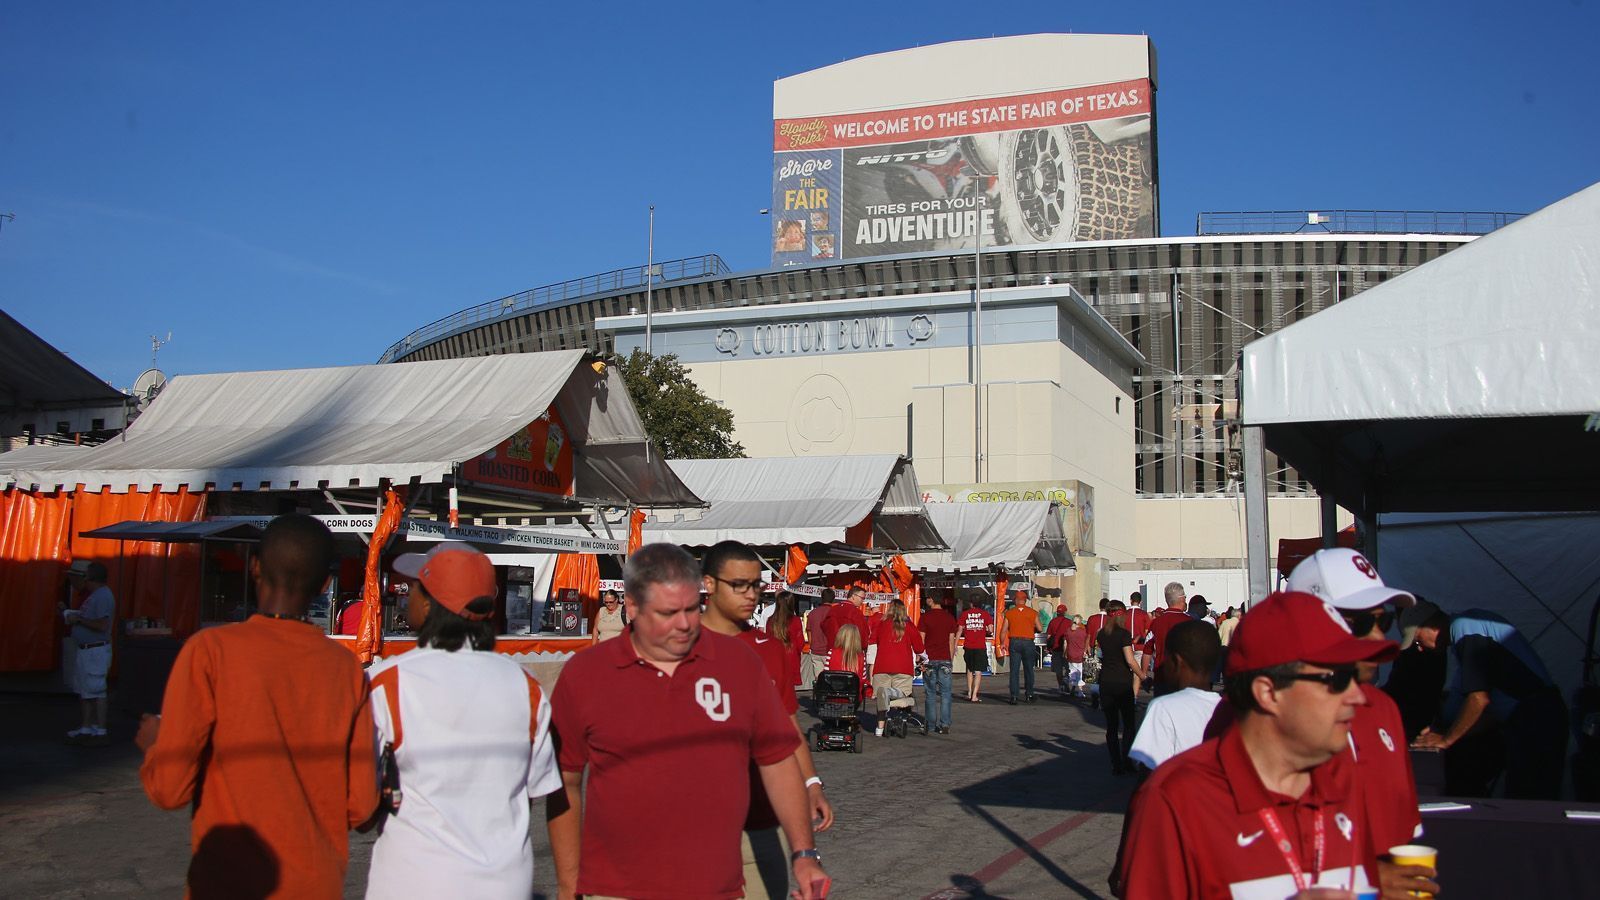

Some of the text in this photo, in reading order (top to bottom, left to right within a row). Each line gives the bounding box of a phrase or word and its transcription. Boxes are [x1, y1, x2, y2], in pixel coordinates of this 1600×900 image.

[833, 89, 1143, 139] WELCOME TO THE STATE FAIR OF TEXAS.
[779, 119, 827, 136] Howdy,
[789, 130, 829, 148] Folks!
[779, 158, 833, 181] Sh@re
[856, 150, 948, 166] NITTO
[799, 178, 816, 188] THE
[784, 188, 829, 211] FAIR
[865, 196, 986, 215] TIRES FOR YOUR
[855, 208, 995, 245] ADVENTURE
[753, 316, 894, 355] COTTON BOWL
[479, 461, 560, 488] ROASTED CORN
[327, 519, 348, 528] CORN
[350, 519, 373, 528] DOGS
[428, 525, 446, 534] CORN
[456, 527, 482, 539] WALKING
[484, 530, 499, 540] TACO
[508, 533, 531, 543] CHICKEN
[533, 535, 553, 545] TENDER
[554, 538, 573, 548] BASKET
[581, 540, 592, 548] MINI
[592, 540, 606, 550] CORN
[607, 542, 620, 551] DOGS
[694, 677, 732, 722] OU
